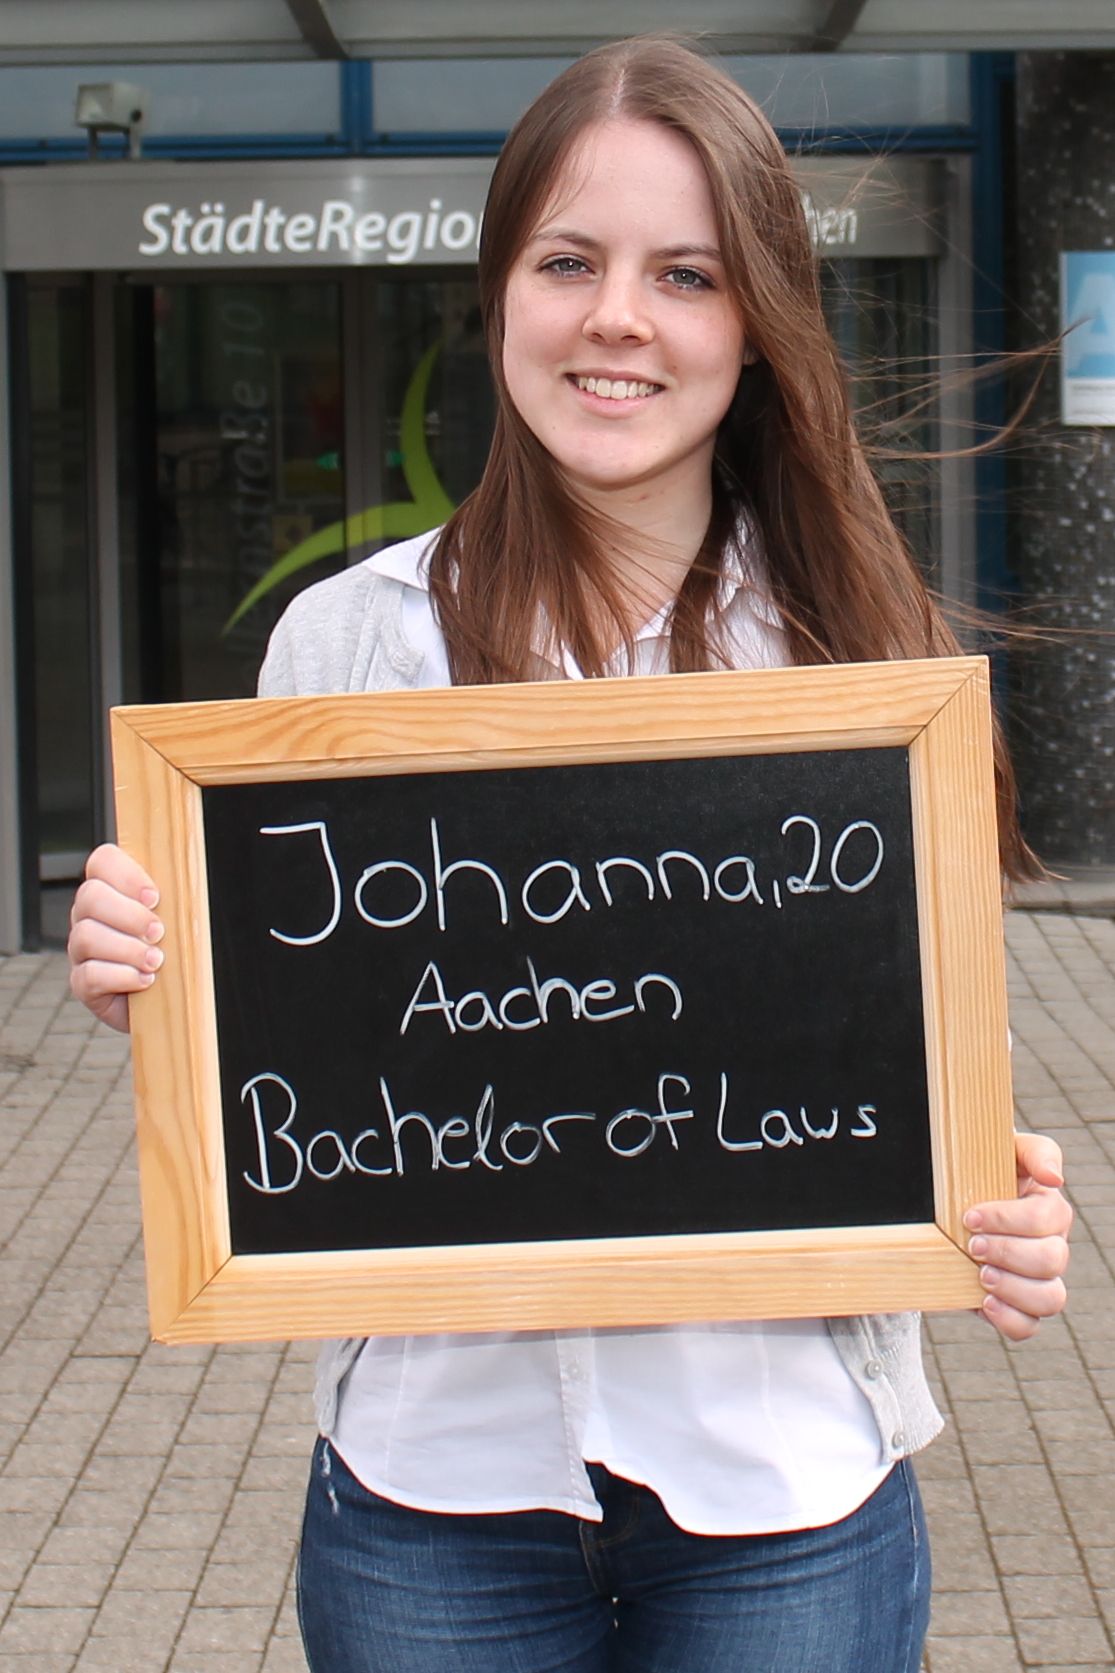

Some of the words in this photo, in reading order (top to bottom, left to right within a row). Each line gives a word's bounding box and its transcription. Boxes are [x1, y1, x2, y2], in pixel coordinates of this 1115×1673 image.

[138, 199, 485, 264] StädteRegio
[801, 190, 858, 245] hen
[400, 957, 683, 1035] Aachen
[241, 1072, 597, 1194] Bachelor
[606, 1074, 694, 1157] of
[717, 1072, 877, 1151] Laws
